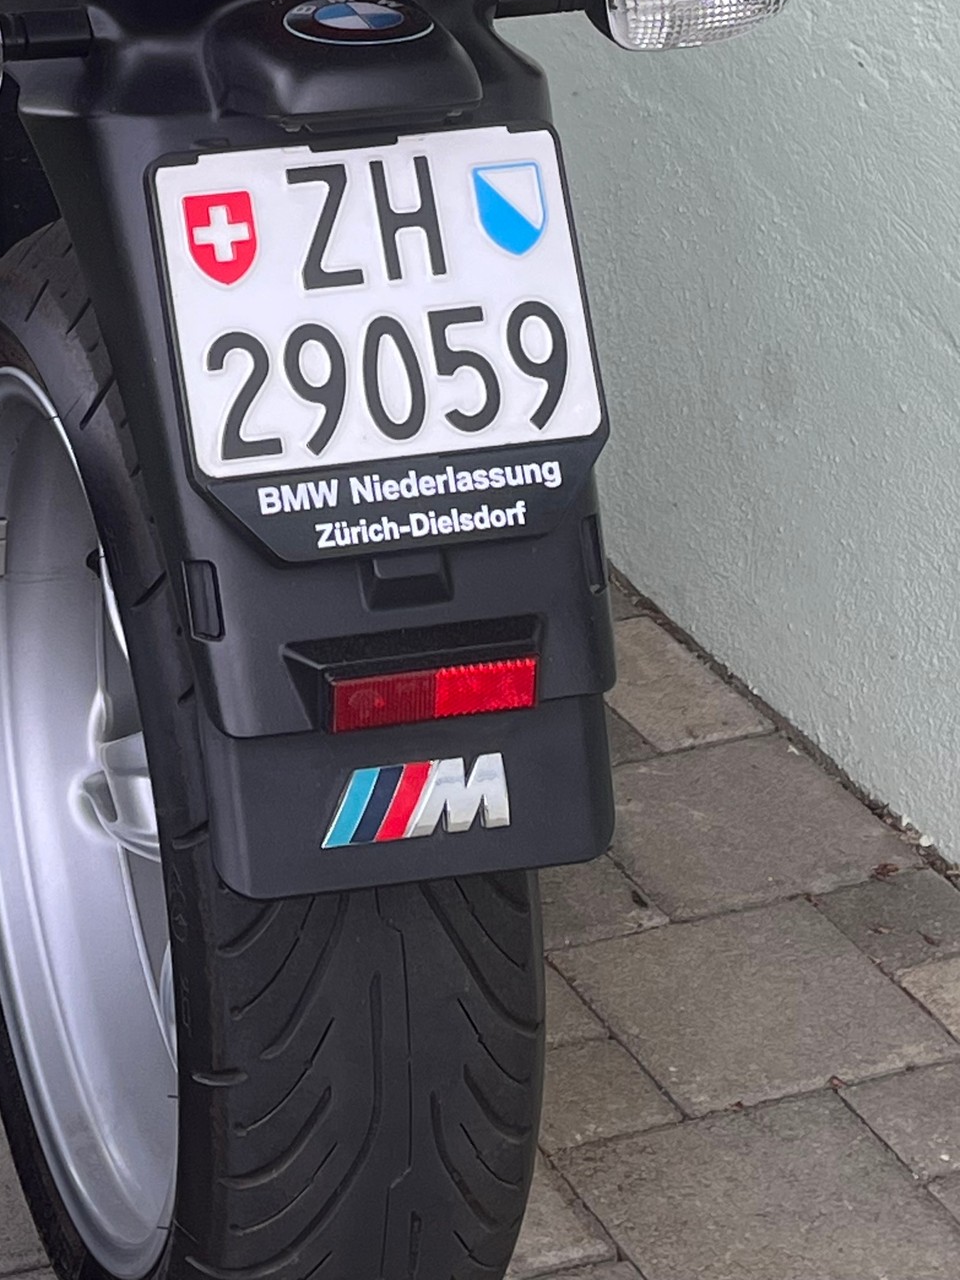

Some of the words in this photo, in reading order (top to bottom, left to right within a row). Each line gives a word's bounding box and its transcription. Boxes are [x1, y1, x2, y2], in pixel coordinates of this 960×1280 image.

[285, 155, 447, 291] ZH
[206, 300, 569, 461] 29059
[257, 479, 339, 516] BMW
[349, 460, 563, 504] Niederlassung
[314, 500, 527, 549] Zürich-Dielsdorf
